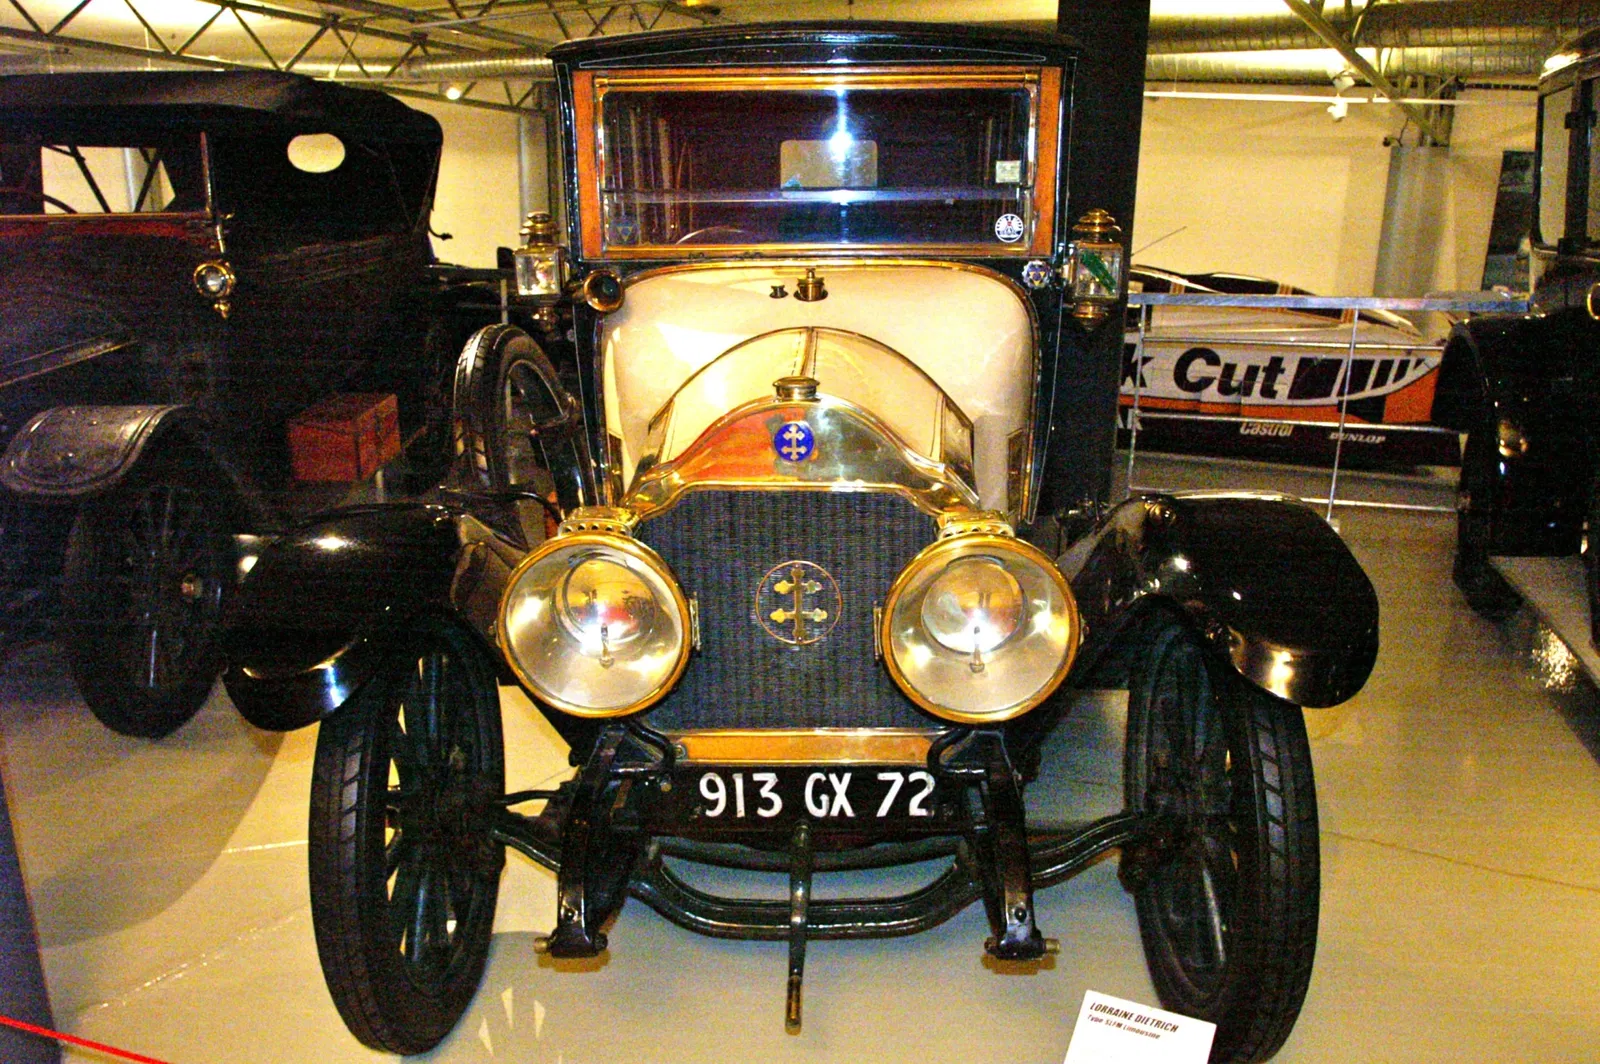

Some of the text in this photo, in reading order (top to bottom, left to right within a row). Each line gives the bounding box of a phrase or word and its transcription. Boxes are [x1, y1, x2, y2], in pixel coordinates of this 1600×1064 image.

[1173, 347, 1285, 400] Cut
[1239, 421, 1294, 437] Castrol
[1329, 432, 1386, 444] DUNLOP
[699, 771, 935, 818] 913 GX 72
[1089, 1002, 1179, 1033] LORRAINE DIETRICH
[1122, 1024, 1161, 1039] Limousine
